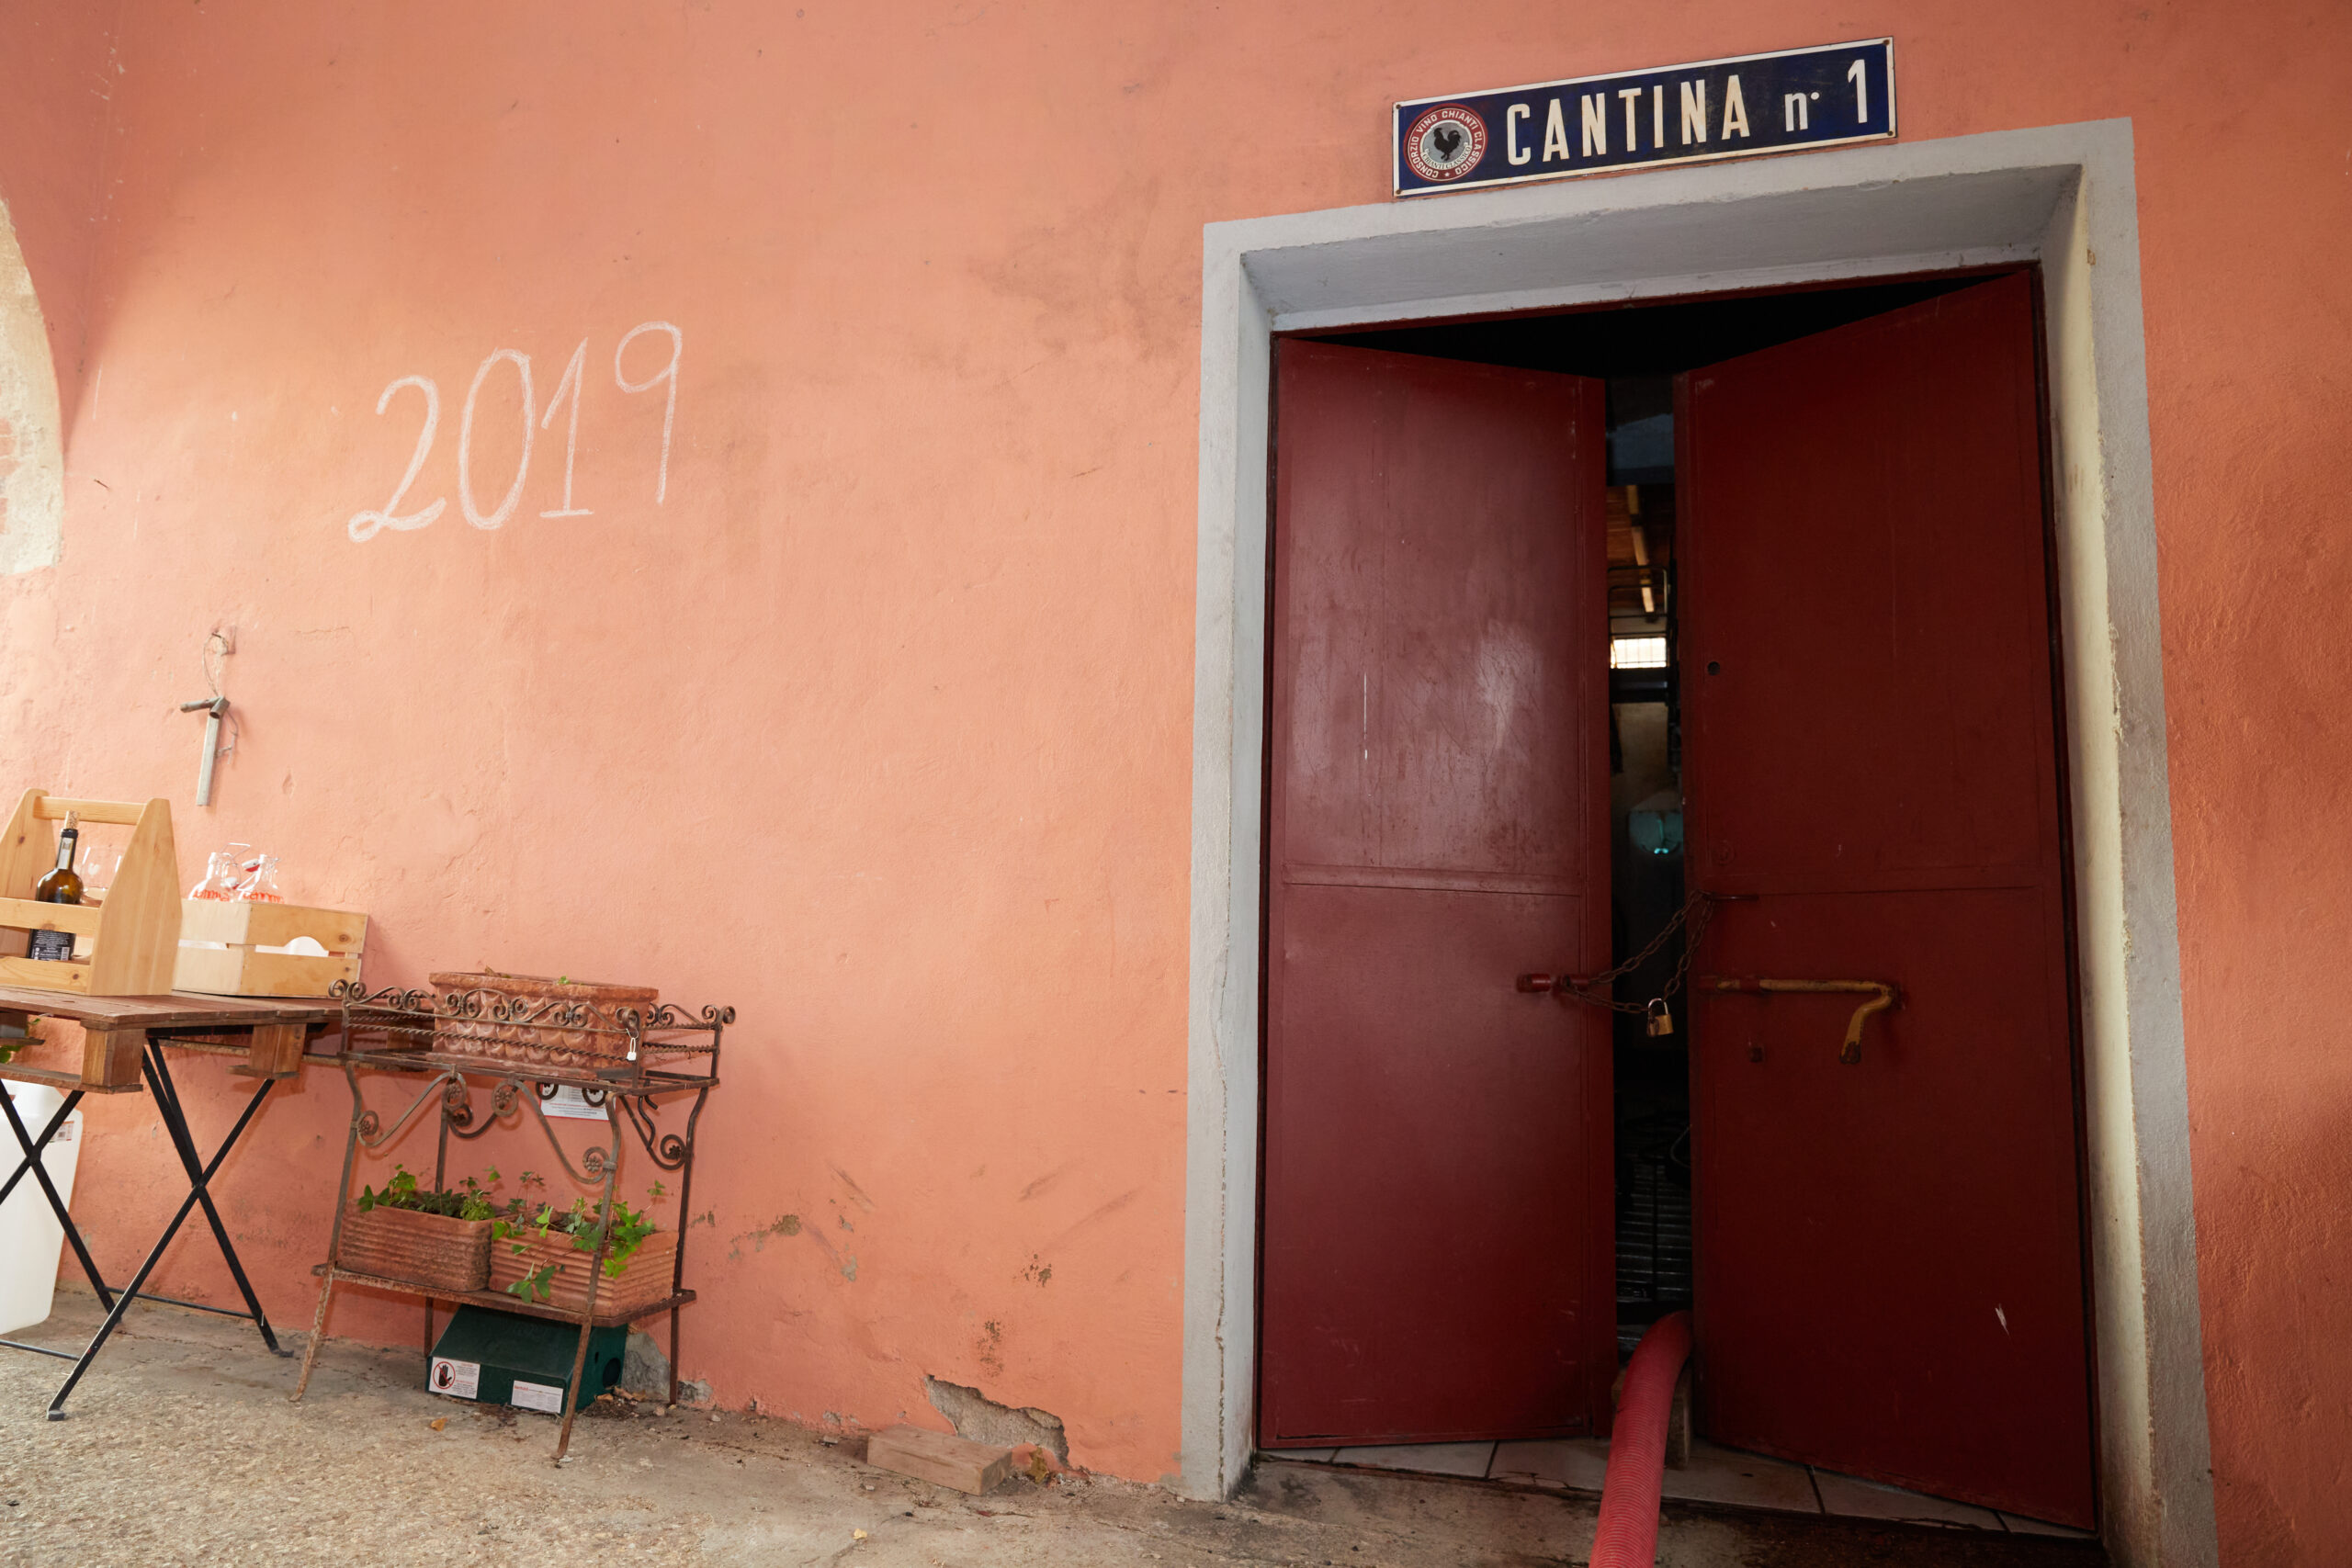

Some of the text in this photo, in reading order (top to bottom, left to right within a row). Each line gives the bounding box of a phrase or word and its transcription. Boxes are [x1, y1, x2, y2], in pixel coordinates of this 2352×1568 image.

[1410, 110, 1483, 178] CONSORZIO VINO CHIANTI CLASSICO
[1507, 74, 1749, 166] CANTINA
[1847, 59, 1868, 124] 1
[348, 321, 682, 543] 2019
